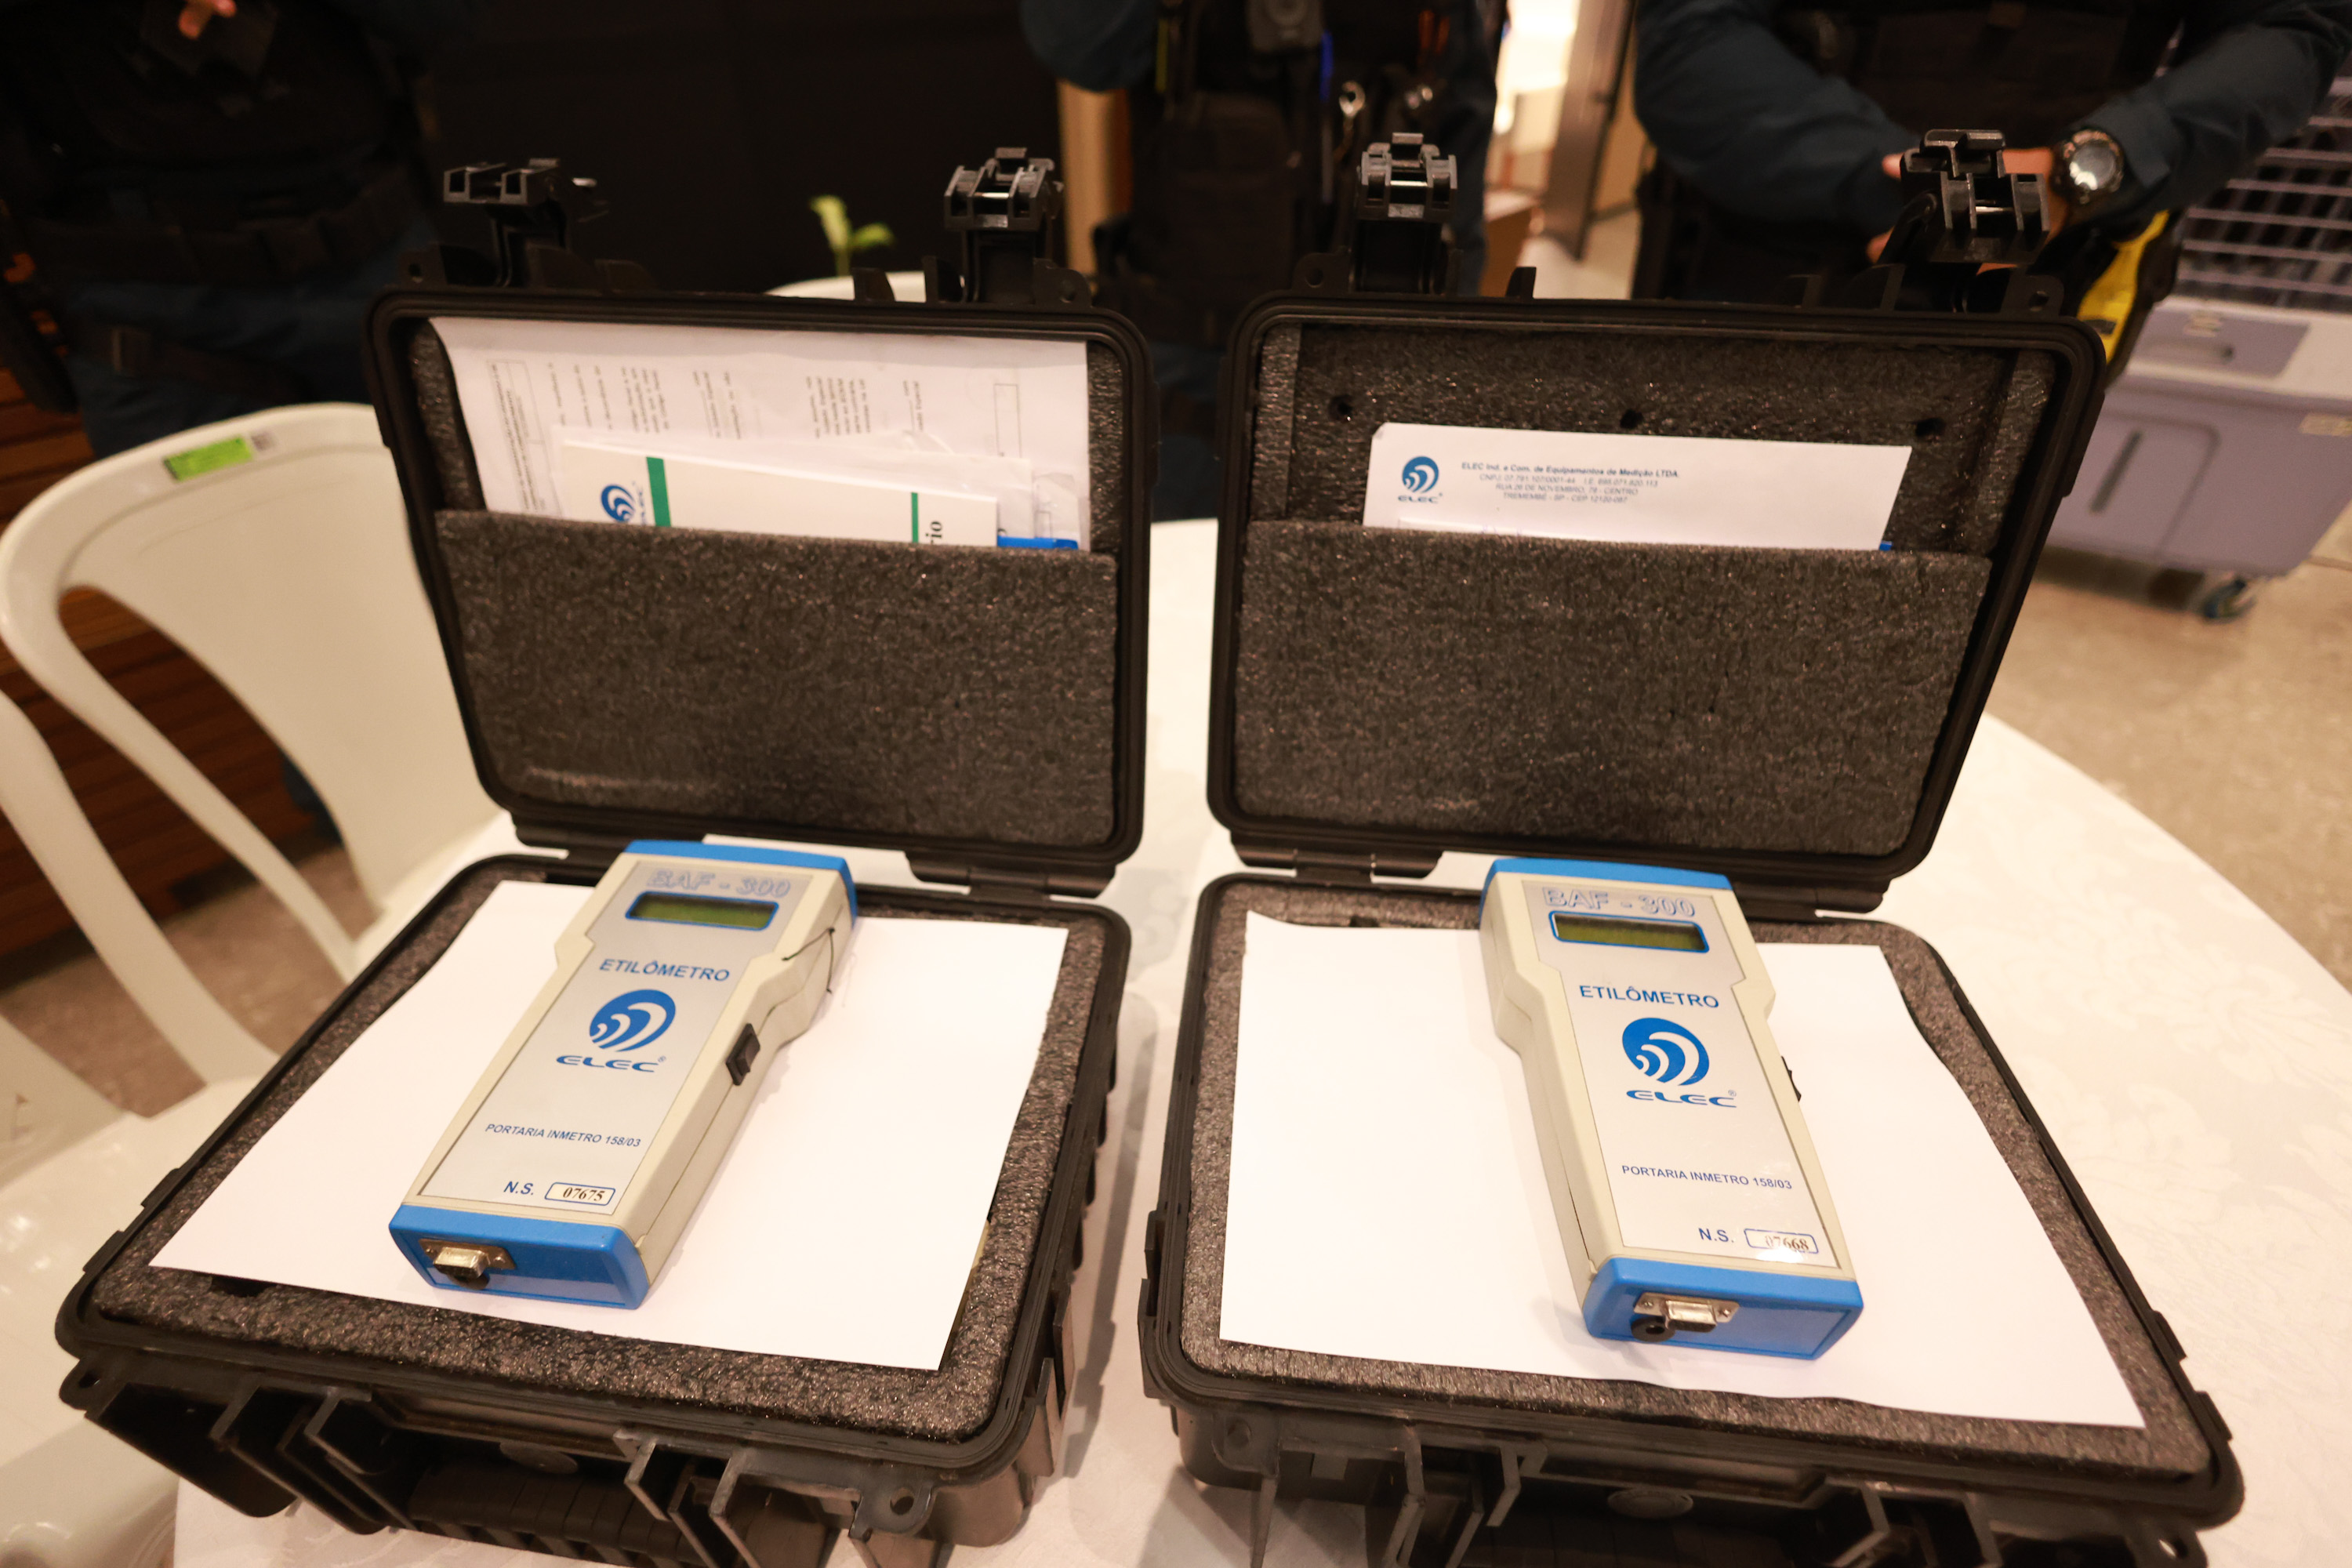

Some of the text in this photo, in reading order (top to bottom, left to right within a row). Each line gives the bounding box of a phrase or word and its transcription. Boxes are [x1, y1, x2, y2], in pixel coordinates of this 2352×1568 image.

[1461, 462, 1484, 470] ELEC
[1398, 495, 1439, 504] ELEC
[646, 869, 716, 891] BAF
[735, 877, 792, 898] 300
[1541, 886, 1610, 910] BAF
[1637, 895, 1696, 917] 300
[599, 958, 731, 982] ETILÔMETRO
[1579, 985, 1720, 1008] ETILÔMETRO
[556, 1054, 659, 1073] ELEC
[1626, 1089, 1737, 1108] ELEC
[485, 1123, 641, 1148] PORTARIA INMETRO 158/03
[1621, 1165, 1793, 1190] PORTARIA INMETRO 158/03
[503, 1181, 606, 1202] N.S. 07675
[1697, 1227, 1810, 1252] N.S. 07668
